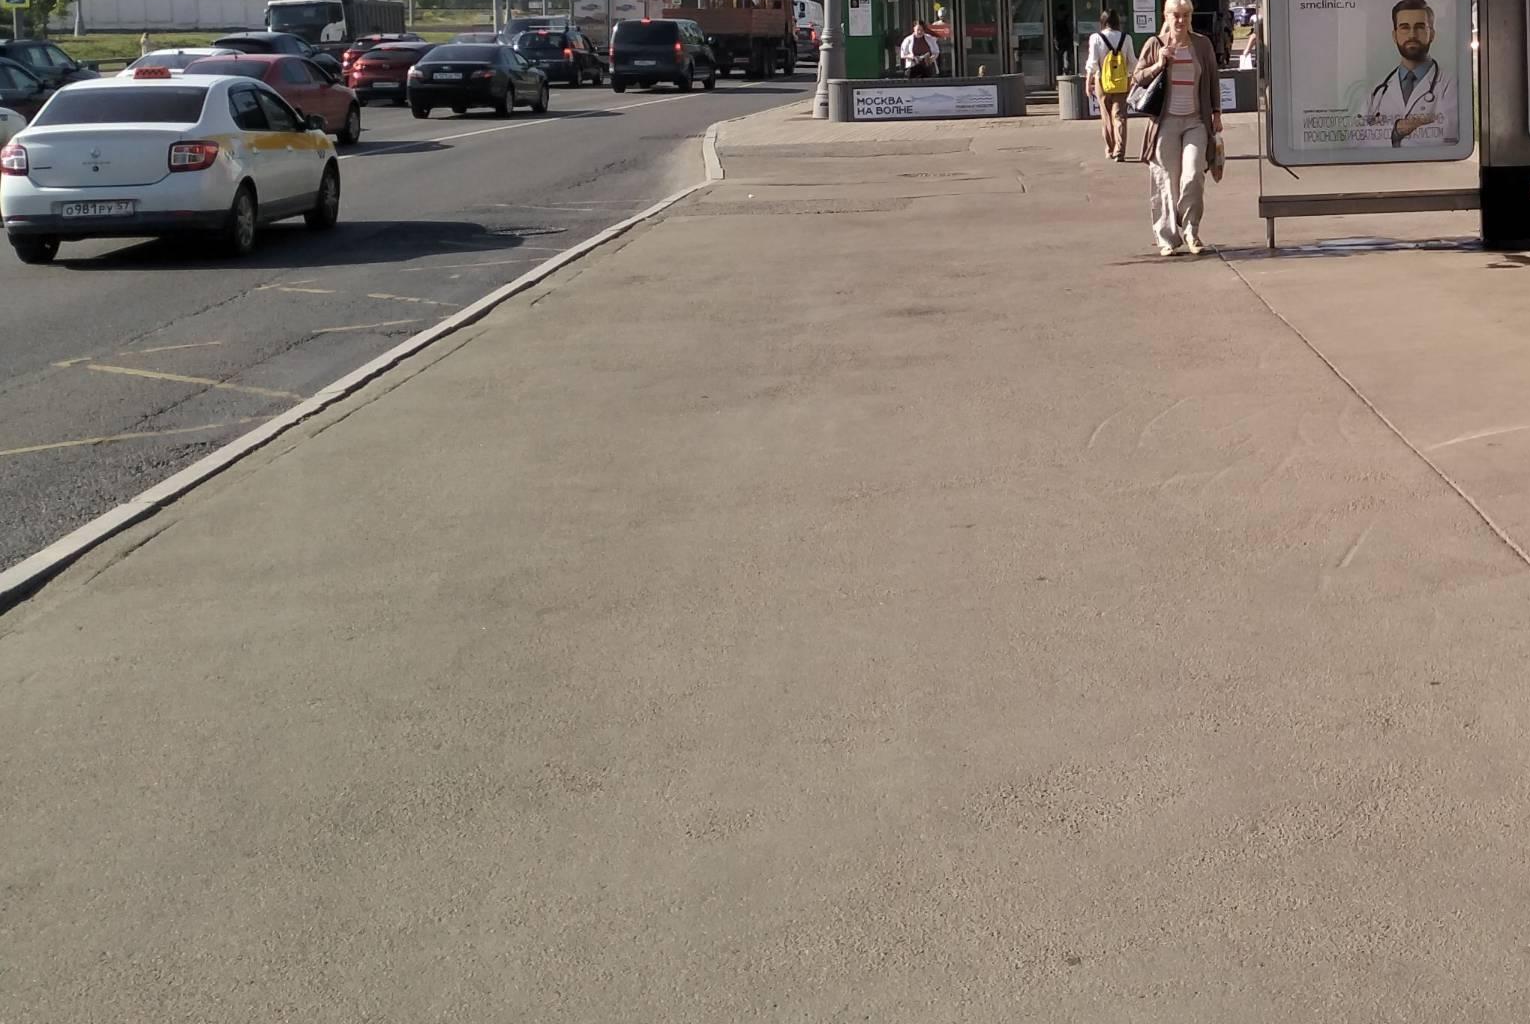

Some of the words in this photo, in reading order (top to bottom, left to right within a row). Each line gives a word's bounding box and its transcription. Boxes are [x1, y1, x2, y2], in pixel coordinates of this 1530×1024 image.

[1300, 0, 1356, 10] smclinic.ru
[857, 95, 904, 106] МОСКВА
[857, 107, 874, 116] НА
[875, 105, 913, 115] ВОЛНЕ
